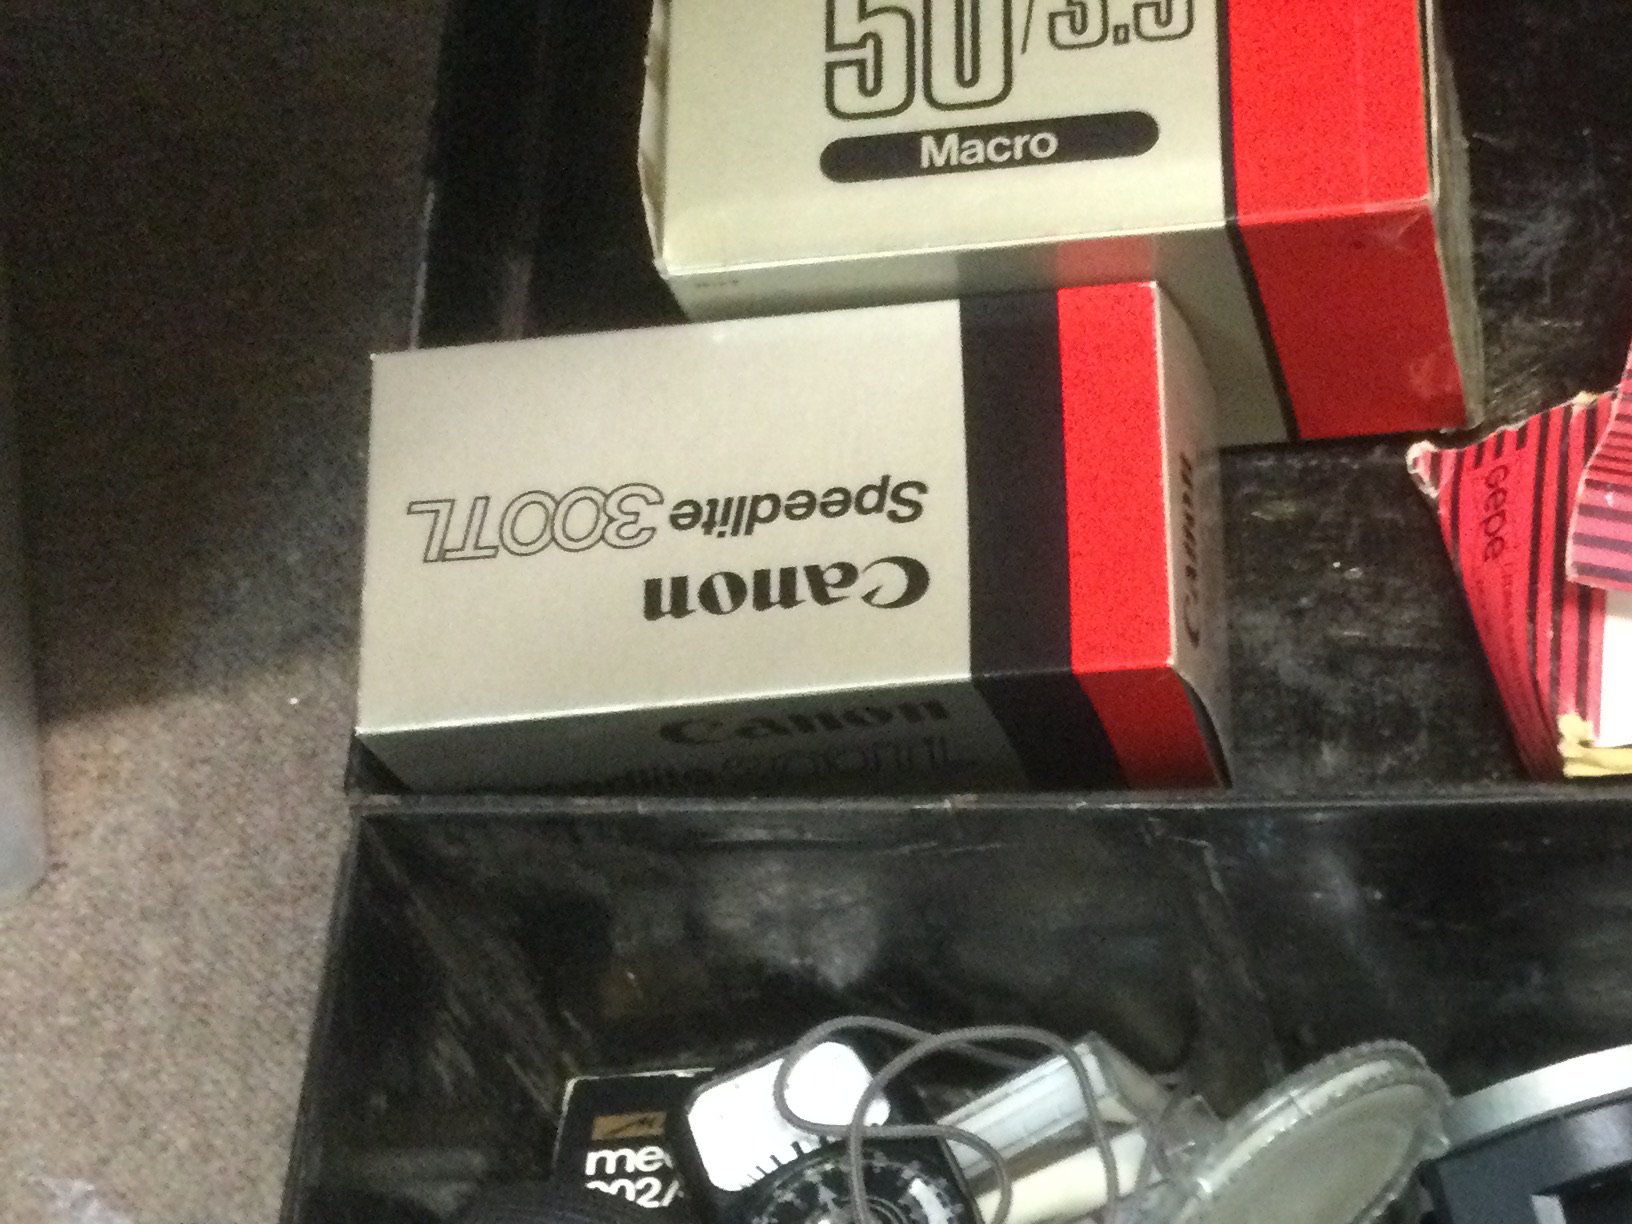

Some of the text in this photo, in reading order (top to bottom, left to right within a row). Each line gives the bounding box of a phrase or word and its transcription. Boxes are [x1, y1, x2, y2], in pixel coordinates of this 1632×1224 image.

[919, 127, 1059, 171] Macro
[407, 474, 928, 563] Speedlite 300TL
[643, 555, 930, 622] Canon
[659, 698, 951, 746] Canon
